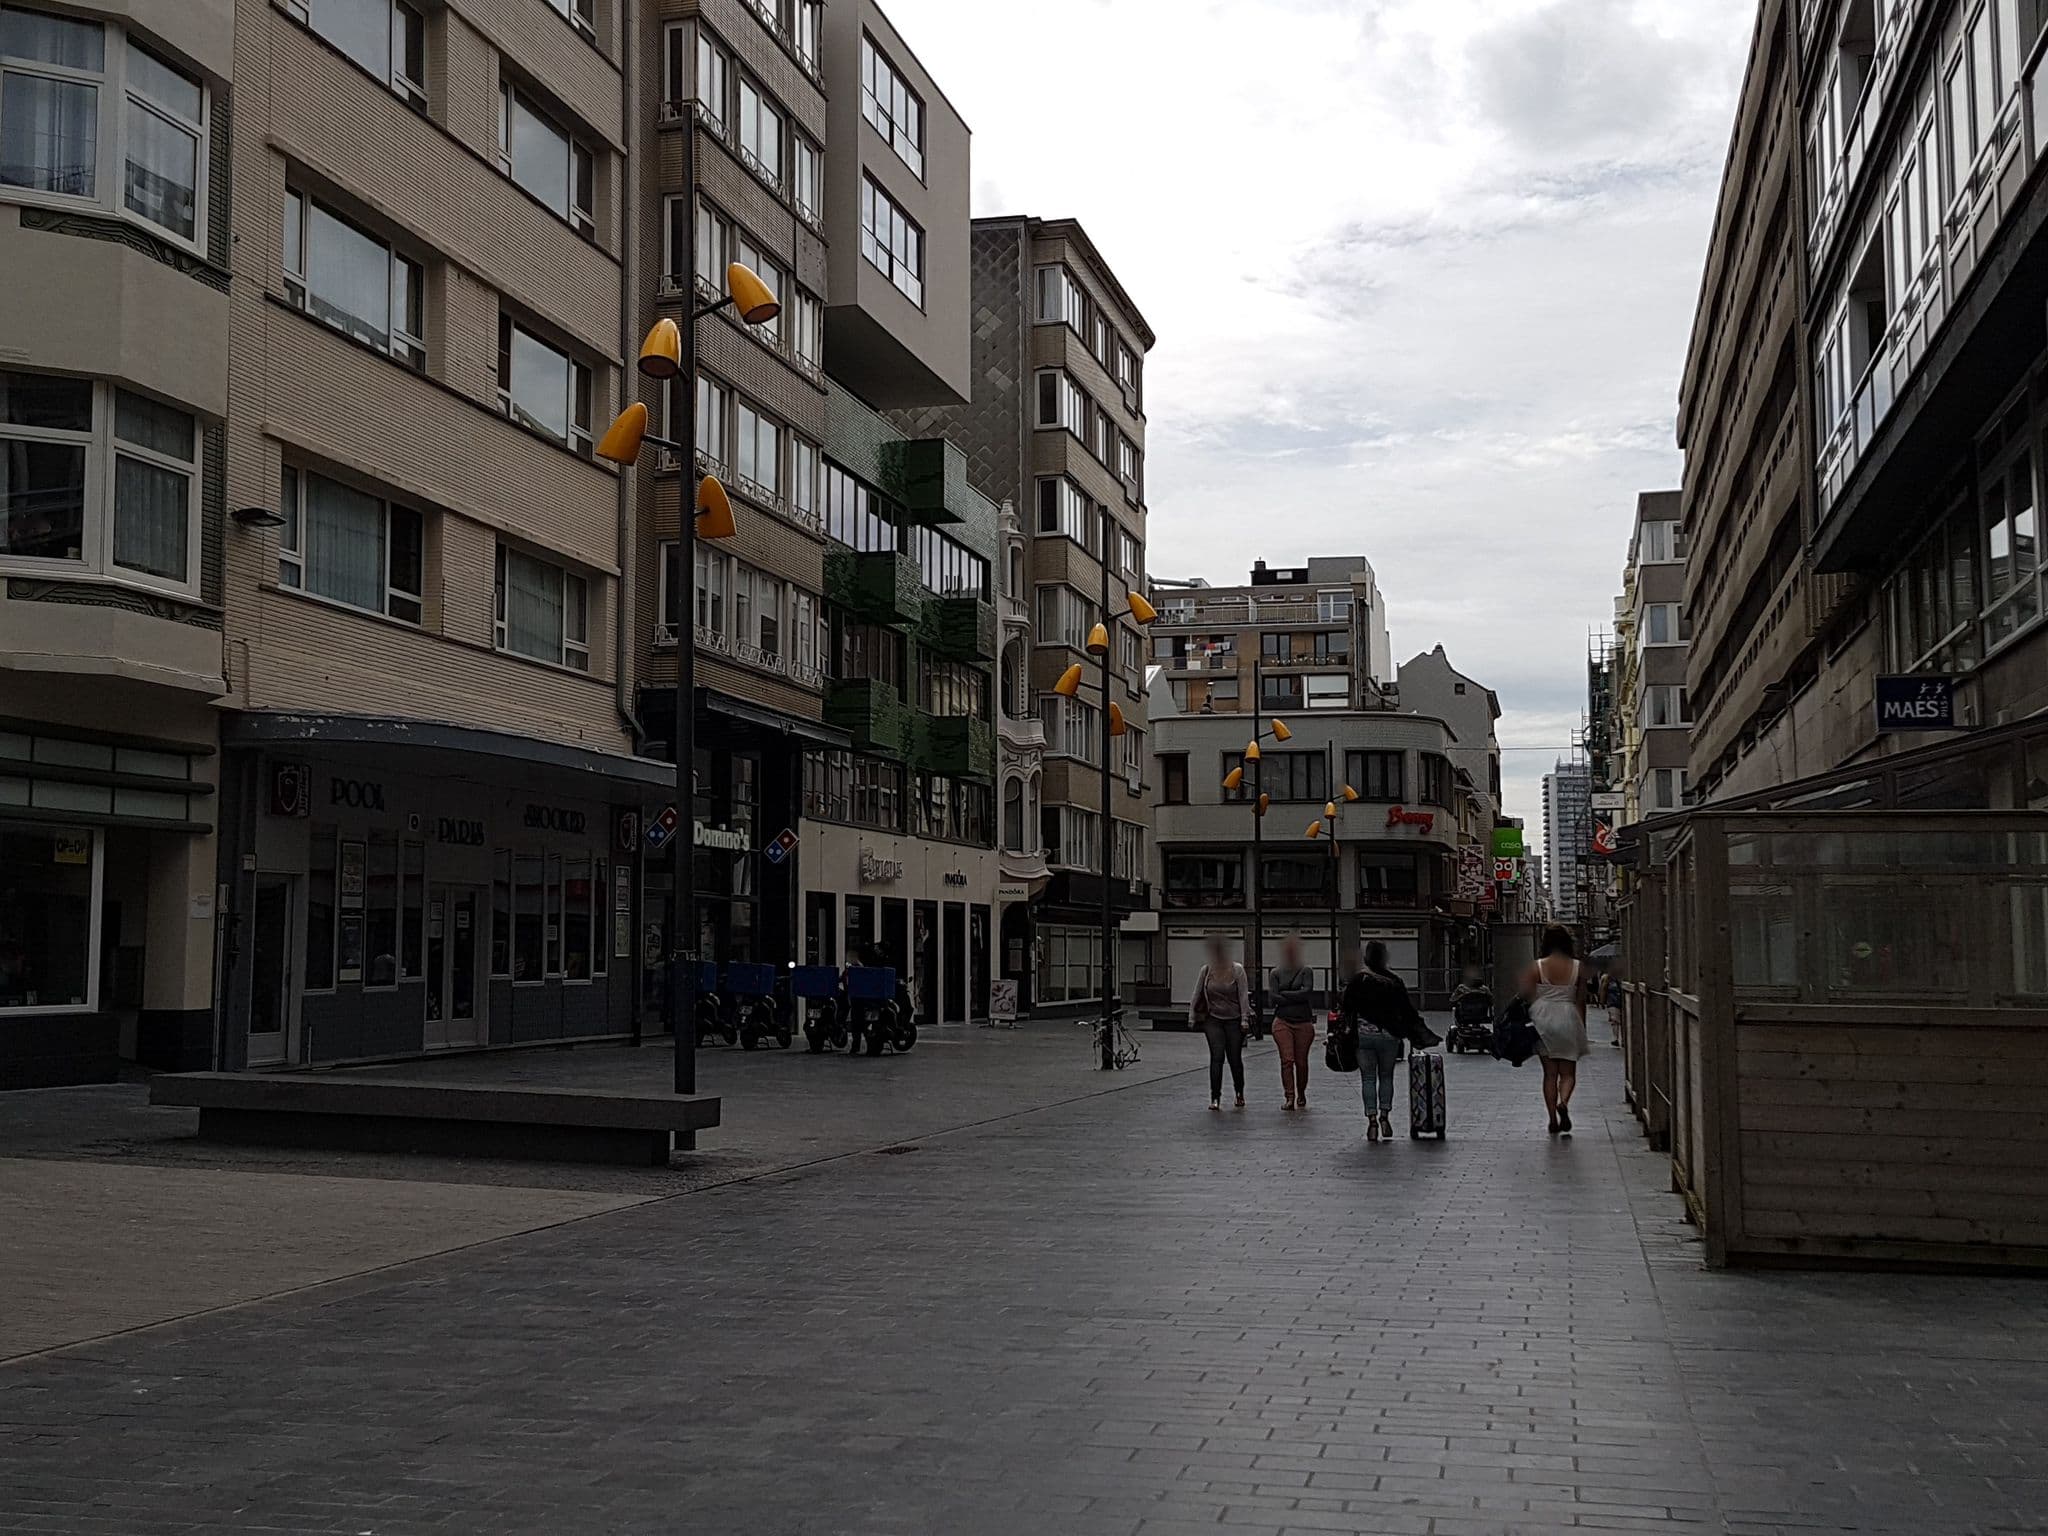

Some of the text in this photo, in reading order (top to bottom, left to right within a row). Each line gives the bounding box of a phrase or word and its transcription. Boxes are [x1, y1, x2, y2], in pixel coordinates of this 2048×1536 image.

[1883, 700, 1940, 719] MAES
[331, 778, 385, 811] POOL
[437, 818, 485, 846] PARIS
[1386, 806, 1434, 834] Benny
[693, 820, 750, 852] Domino's
